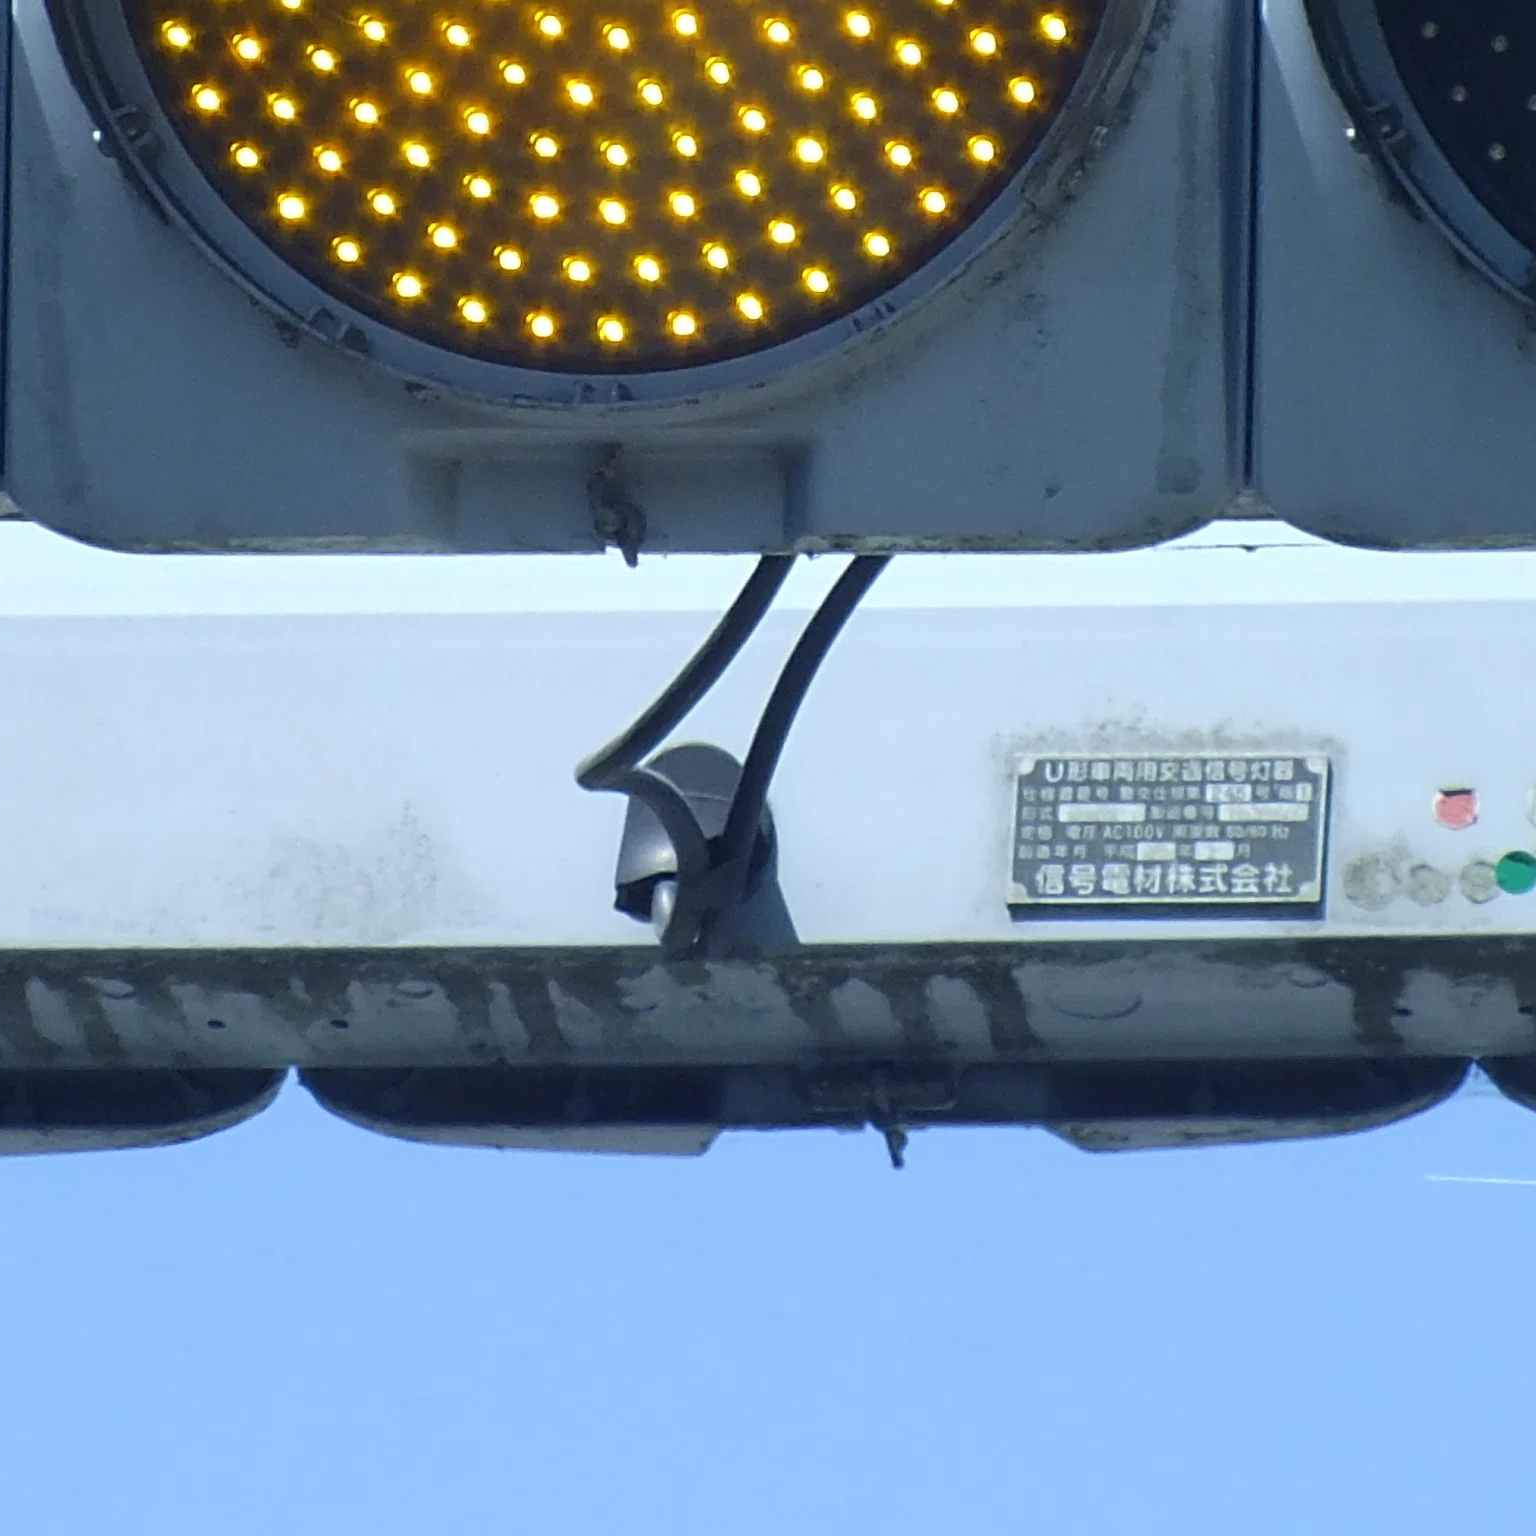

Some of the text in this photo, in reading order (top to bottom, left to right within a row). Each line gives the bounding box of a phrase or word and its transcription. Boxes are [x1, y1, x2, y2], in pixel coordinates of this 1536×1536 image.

[1035, 864, 1294, 895] 信号電材株式会社
